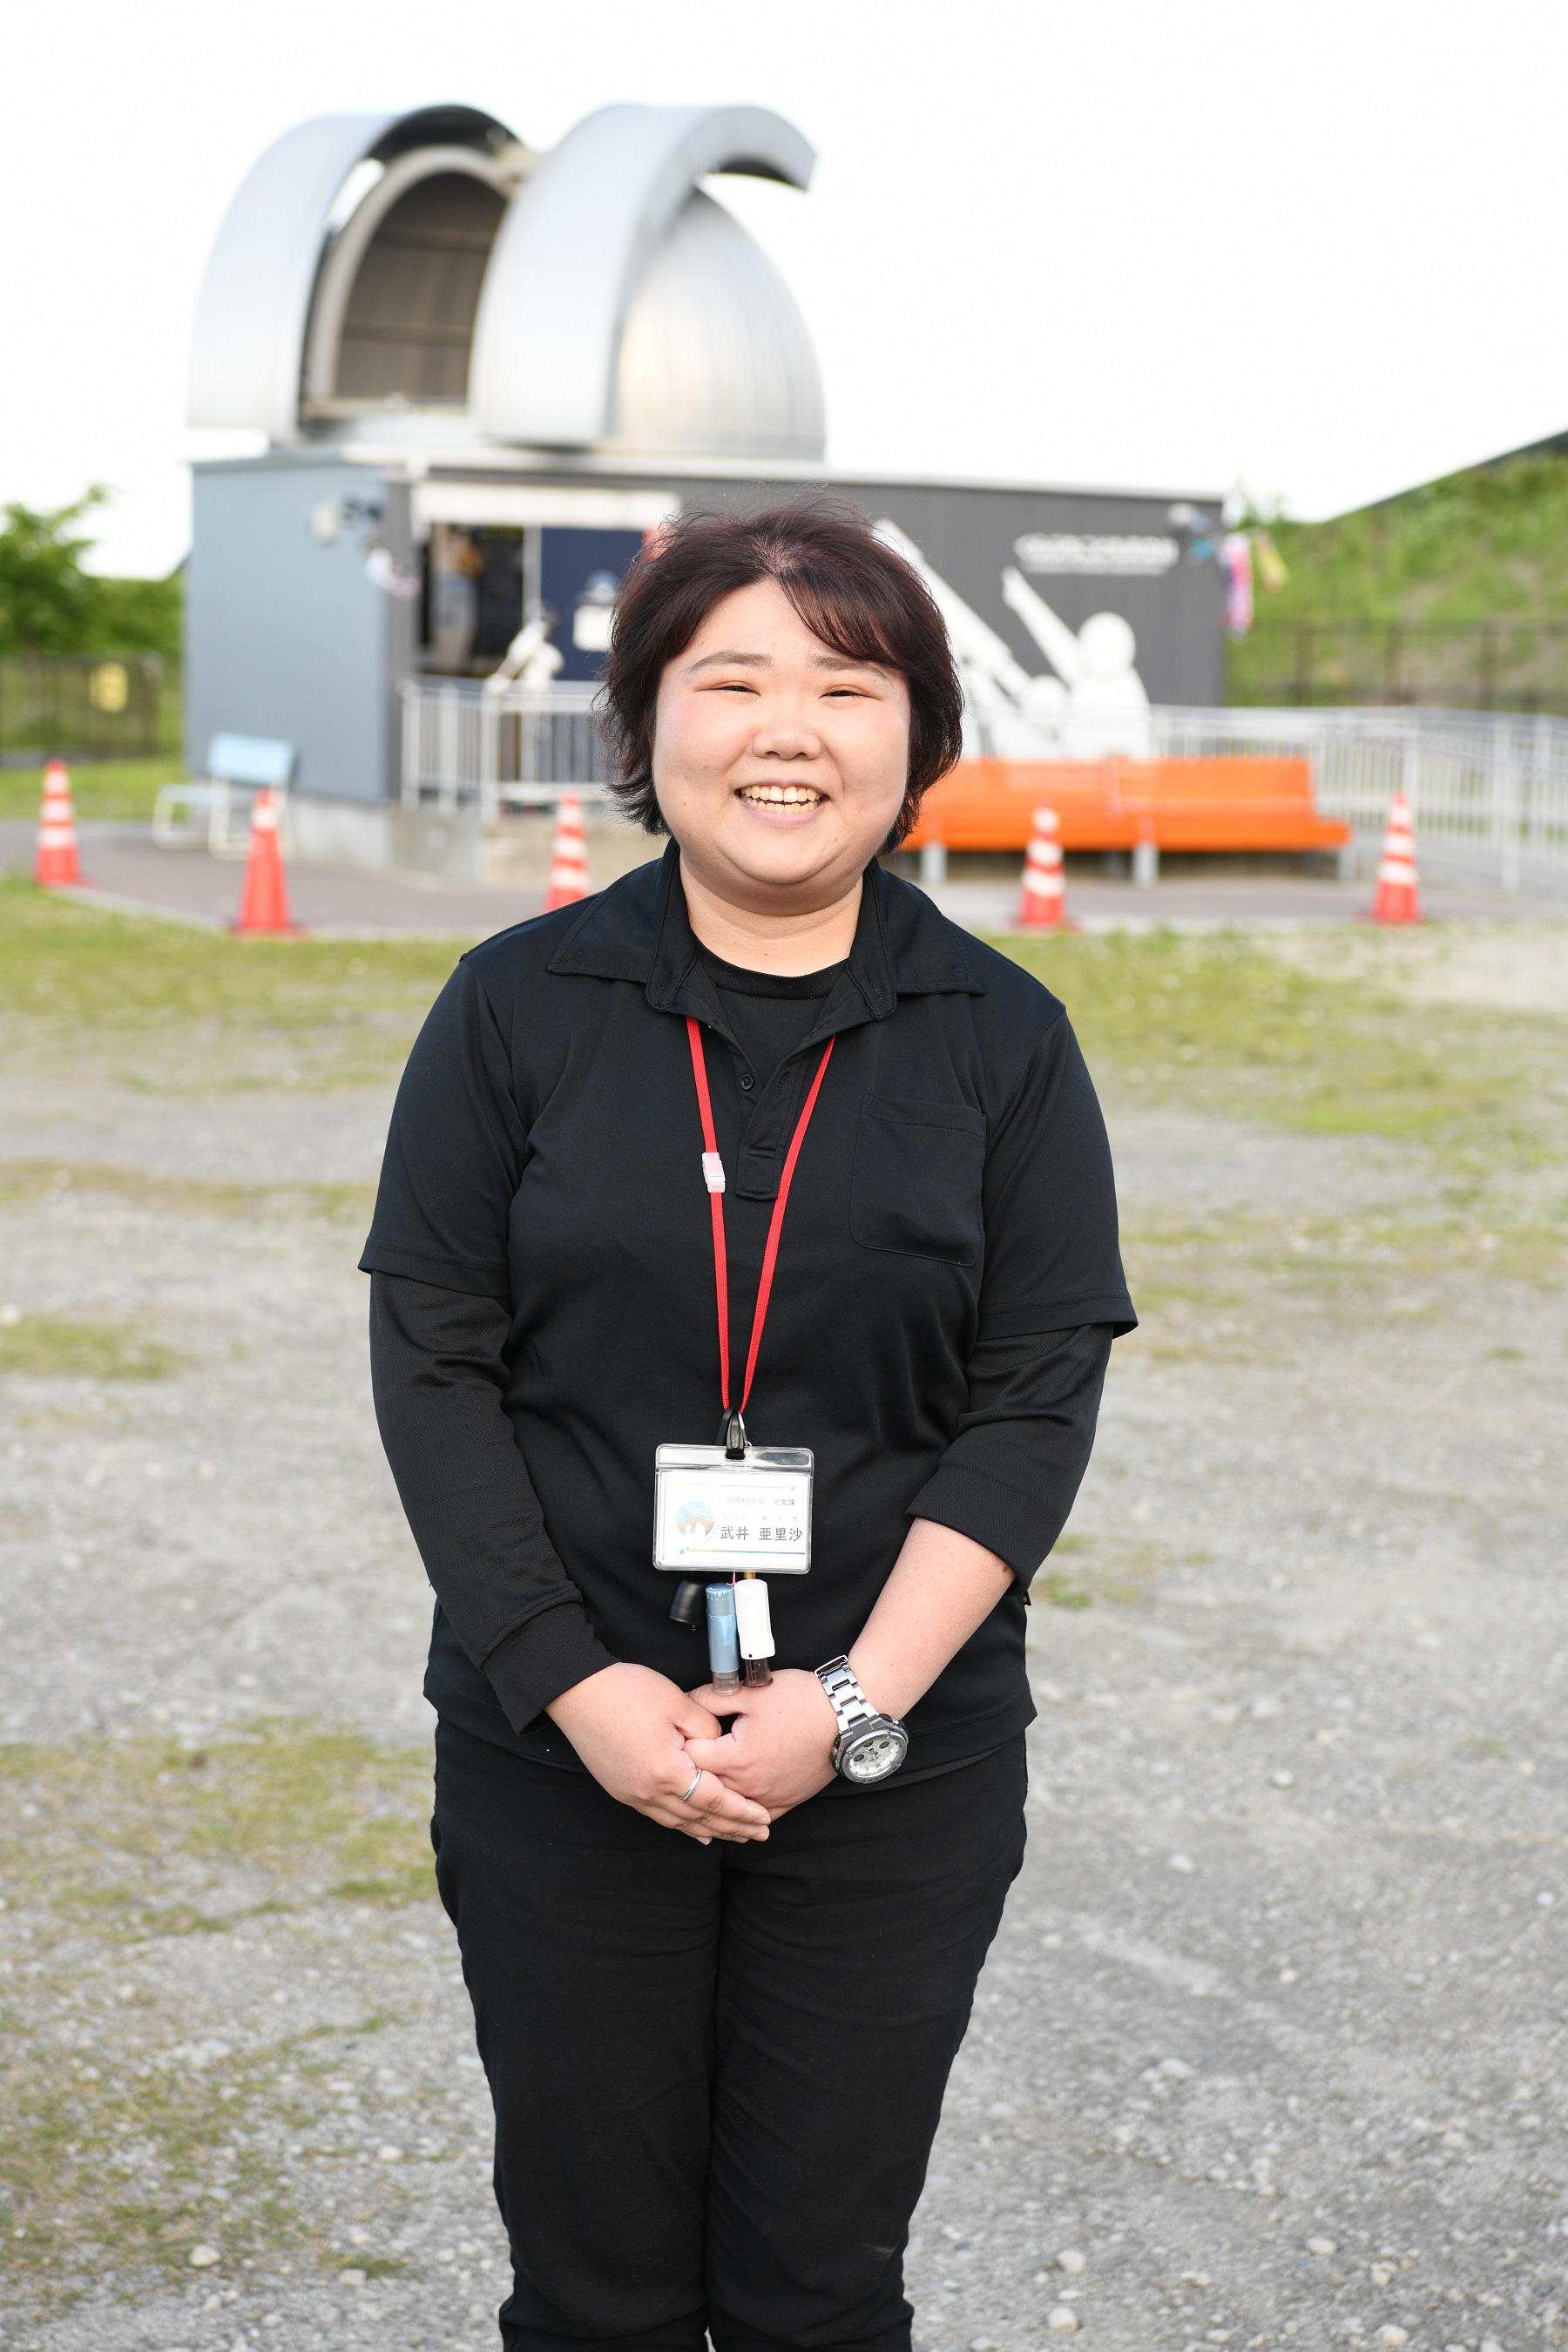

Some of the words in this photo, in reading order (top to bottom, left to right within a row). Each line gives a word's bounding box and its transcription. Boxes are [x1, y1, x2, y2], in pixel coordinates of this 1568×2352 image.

[720, 1525, 750, 1541] 武井
[758, 1527, 803, 1542] 亜里沙
